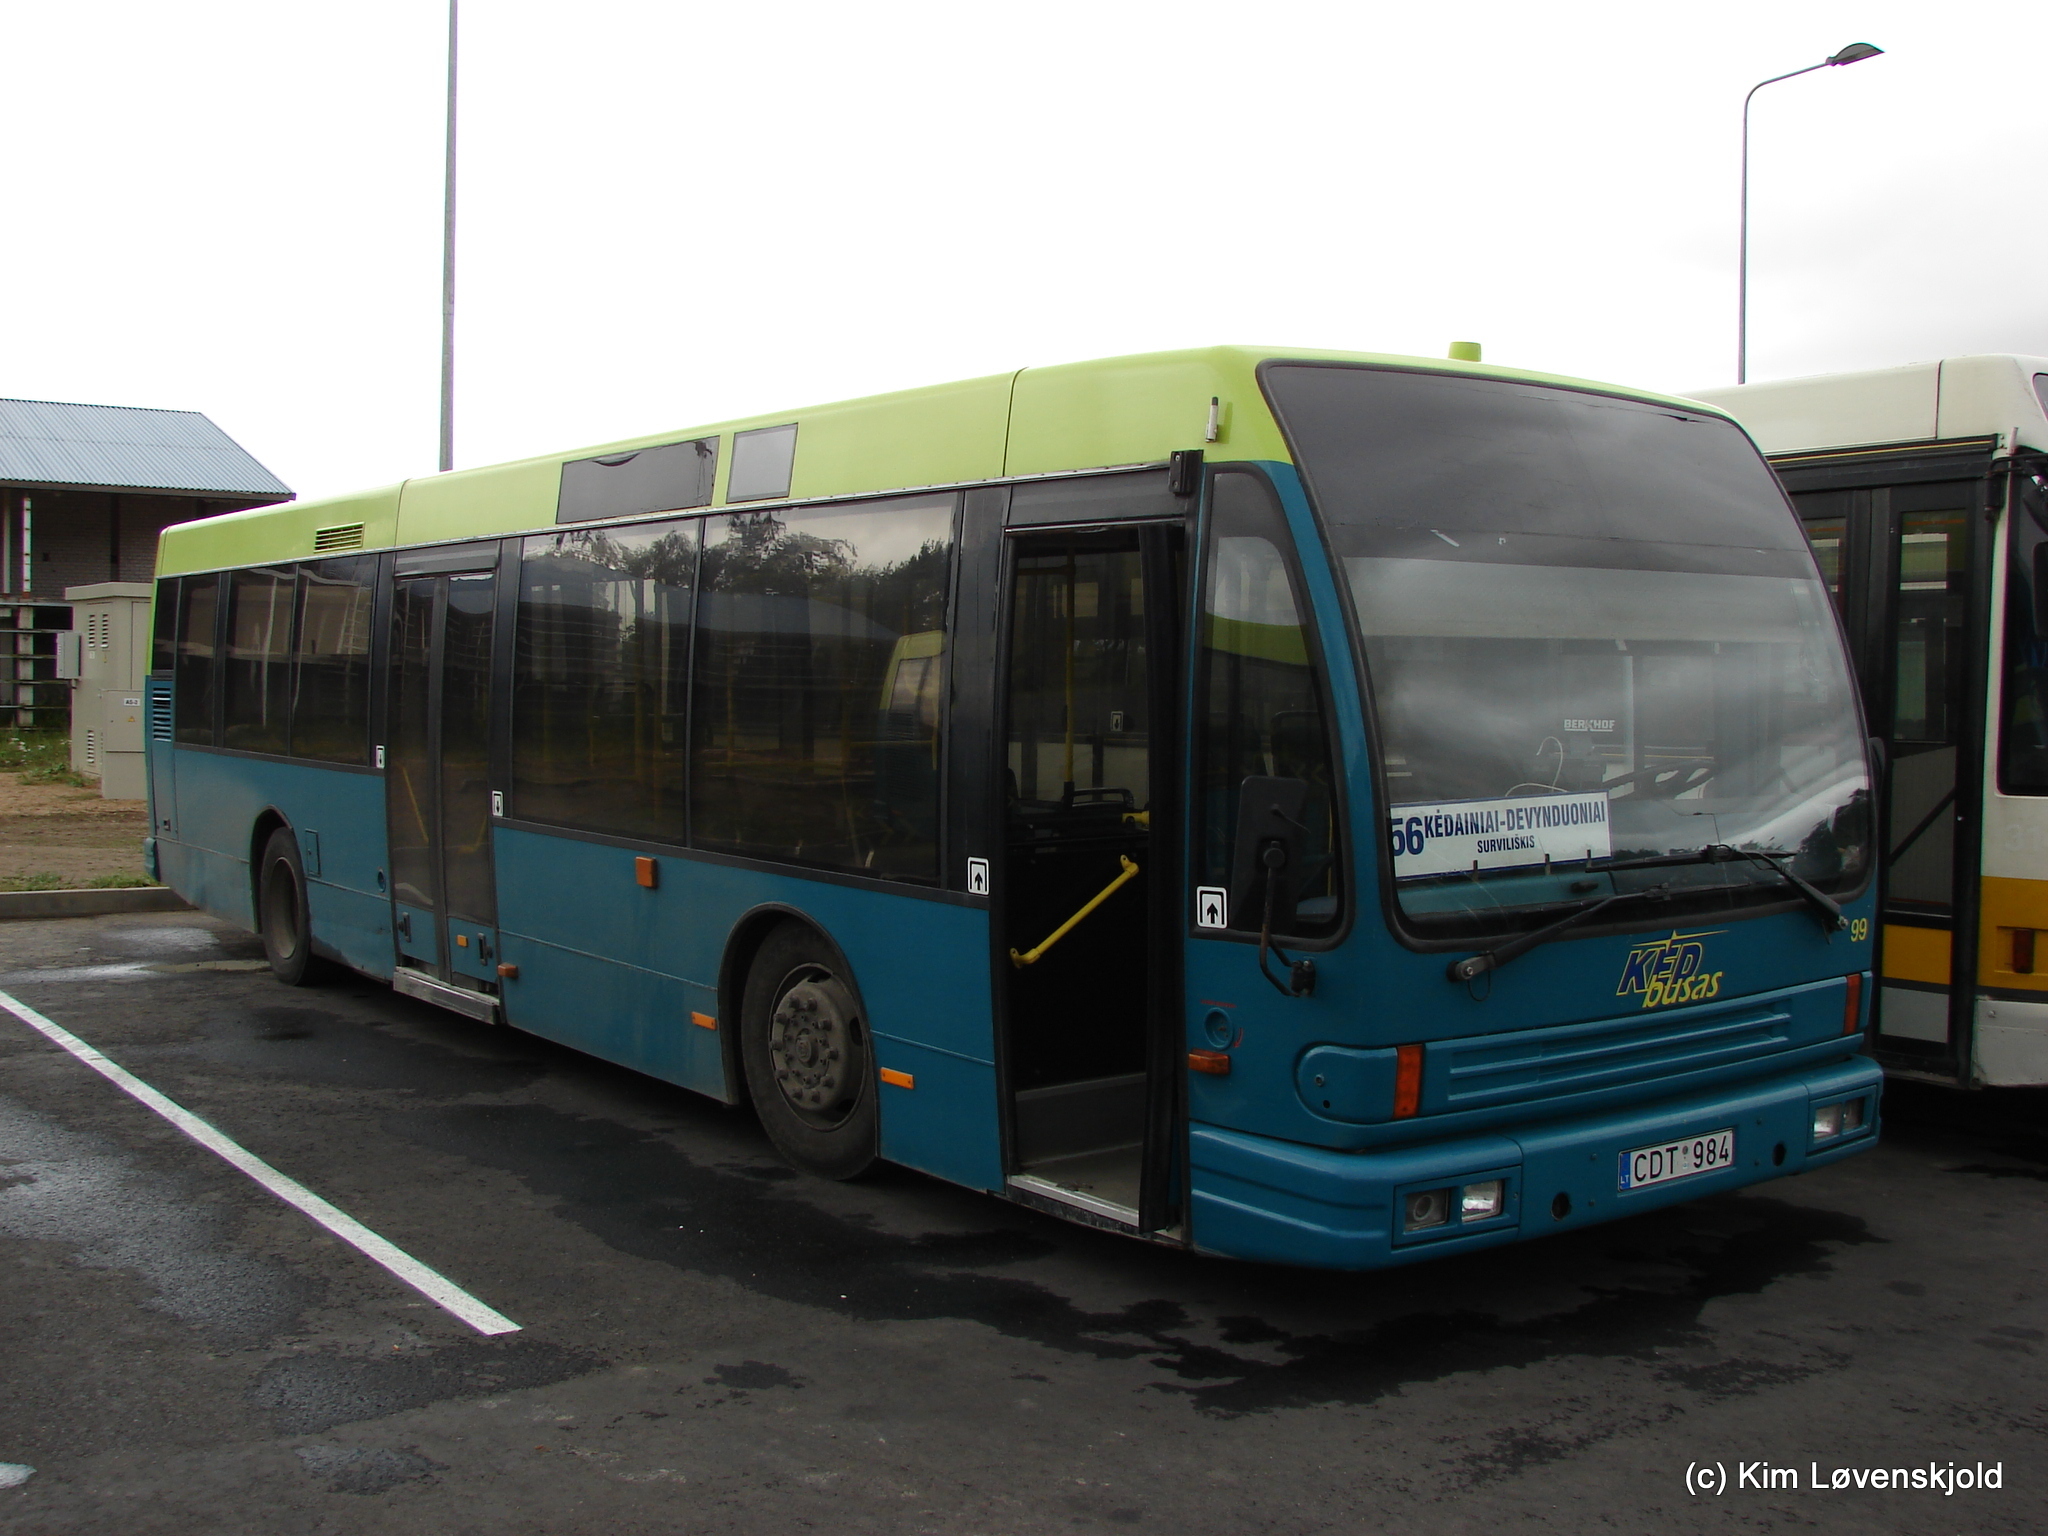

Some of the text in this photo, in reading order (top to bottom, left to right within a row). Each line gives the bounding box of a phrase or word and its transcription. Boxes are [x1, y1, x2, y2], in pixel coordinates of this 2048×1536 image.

[1563, 719, 1616, 731] BERKHOF
[1391, 801, 1606, 857] 56 KĖDAINIAI-DEVYNDUONIAI
[1477, 833, 1536, 854] SURVILIŠKIS
[1850, 917, 1869, 942] 99
[1642, 971, 1724, 1008] busas
[1620, 1135, 1729, 1184] LT CDT 984
